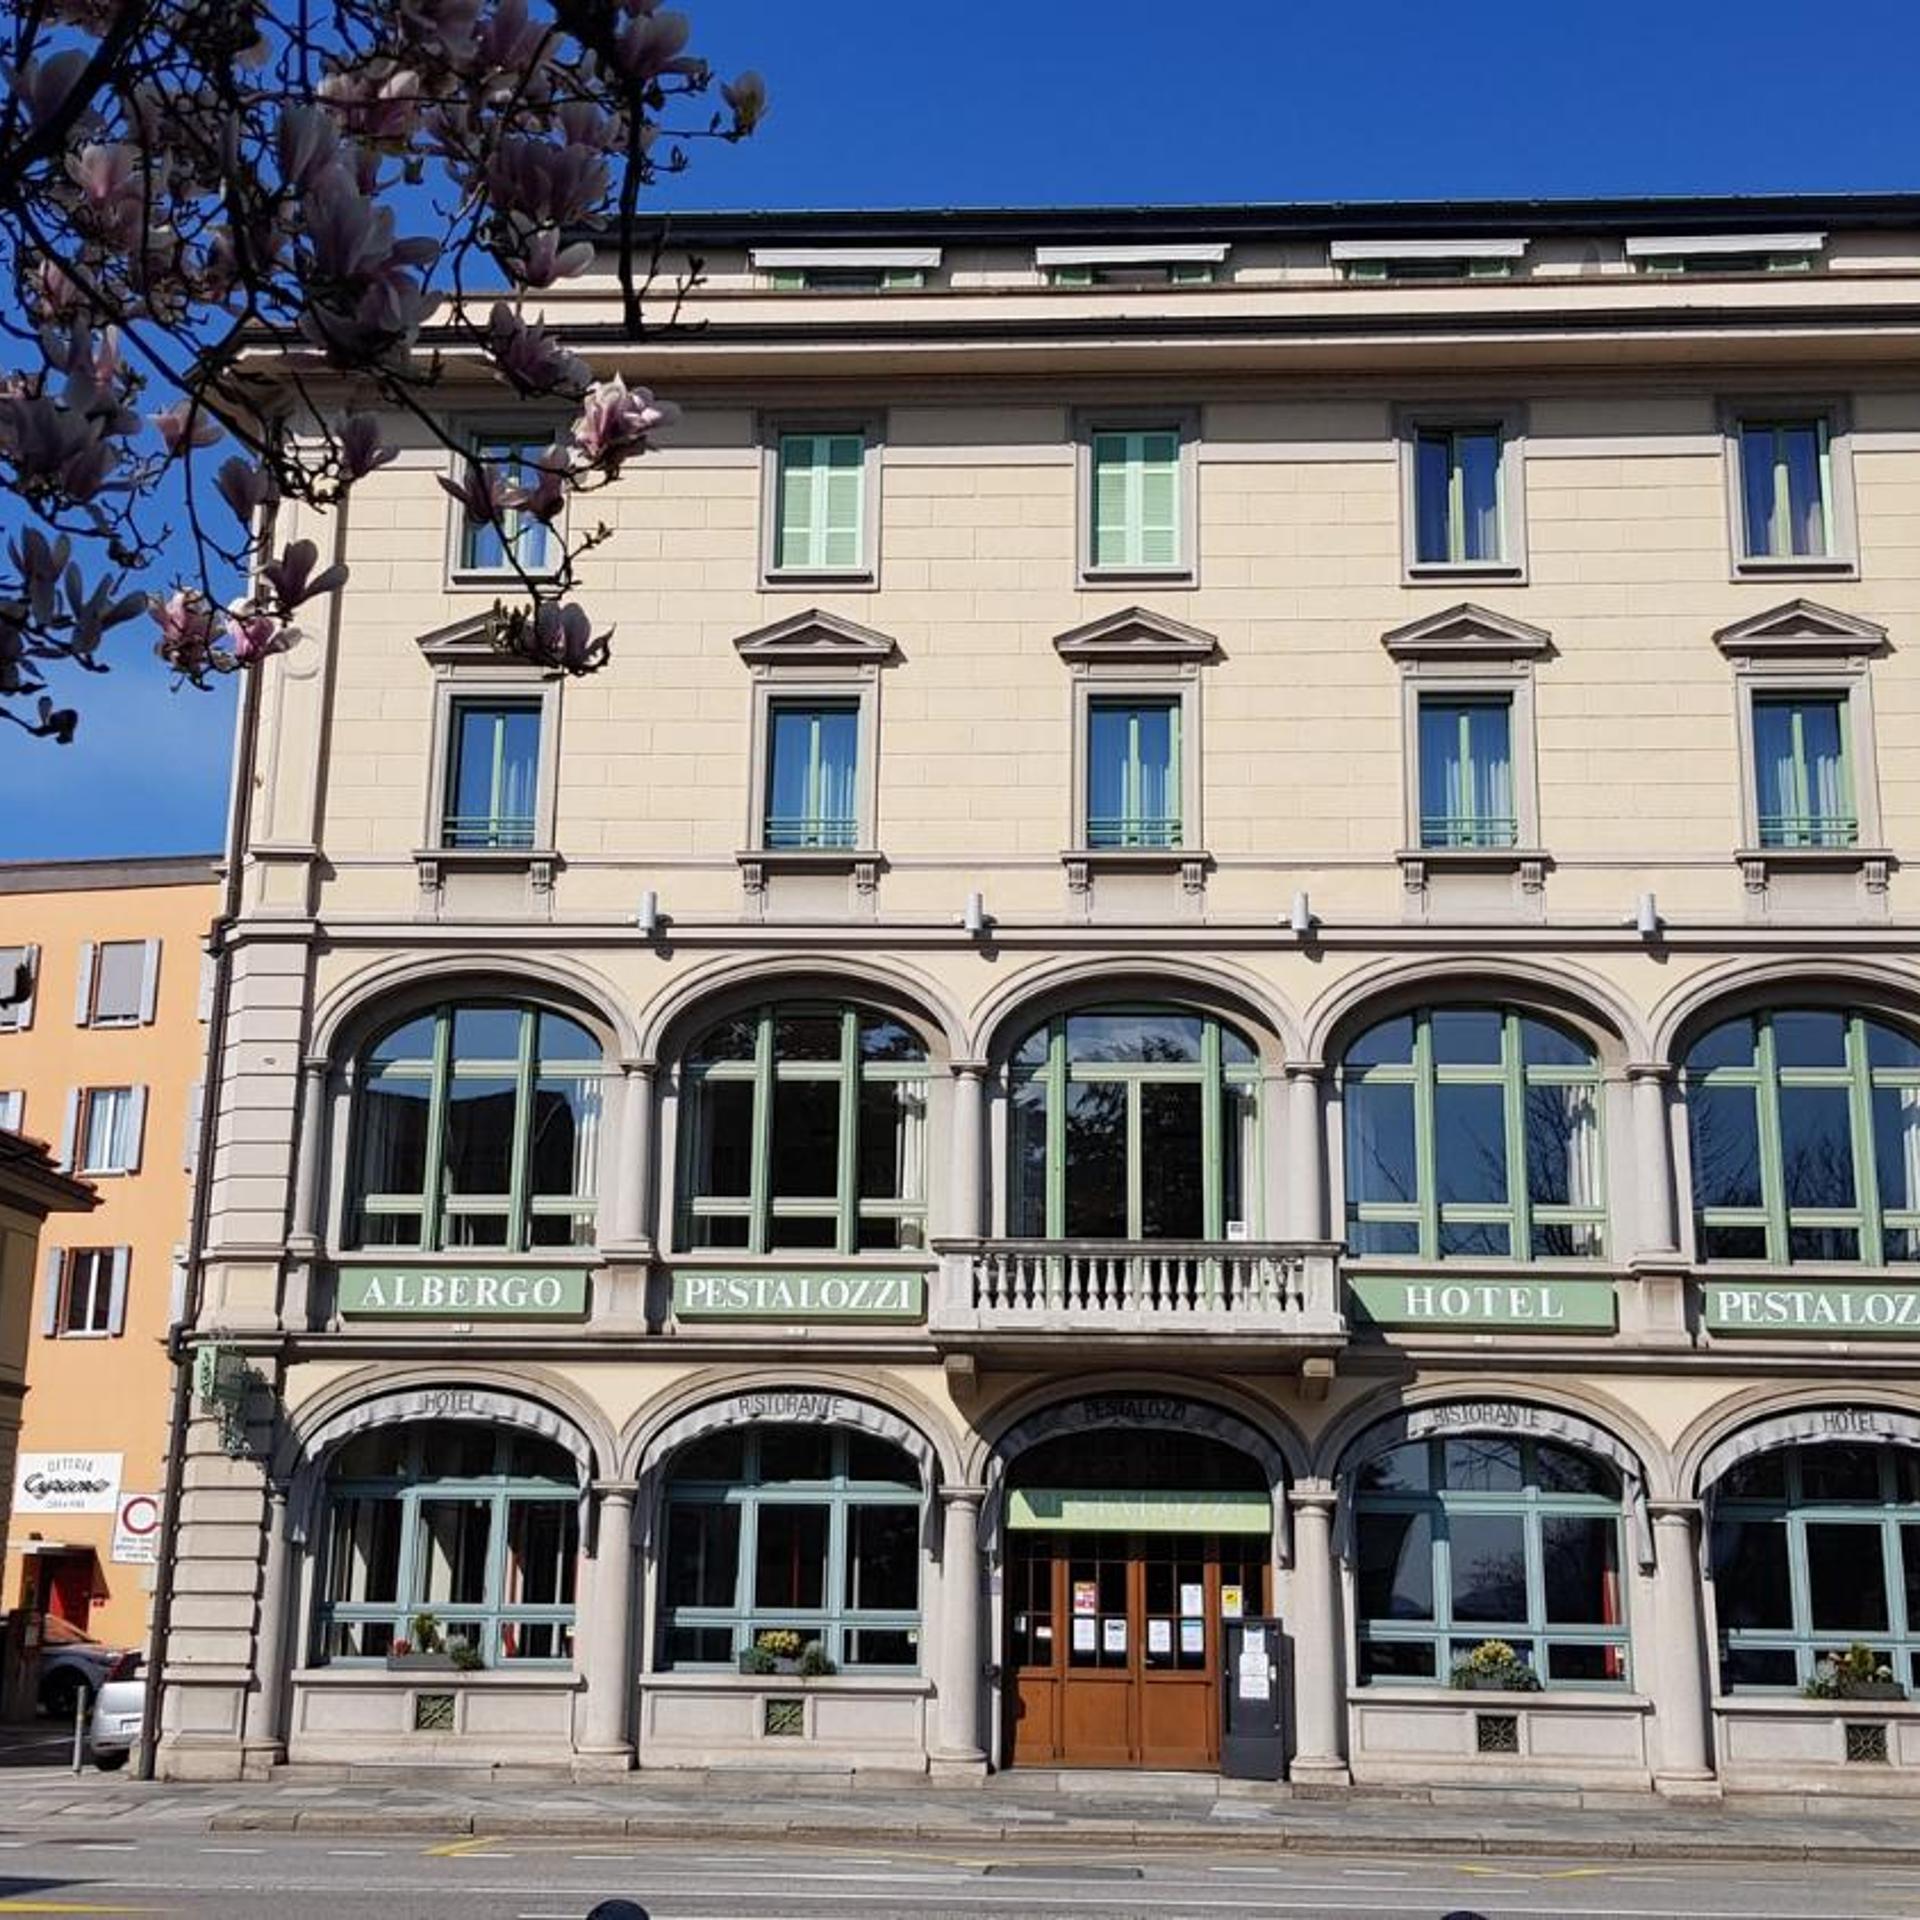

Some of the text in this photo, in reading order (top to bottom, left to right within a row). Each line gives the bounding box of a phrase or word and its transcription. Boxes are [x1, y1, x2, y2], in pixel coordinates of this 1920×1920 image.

[362, 1276, 562, 1307] ALBERGO
[685, 1277, 911, 1310] PESTALOZZI
[1405, 1286, 1564, 1318] HOTEL
[424, 1393, 475, 1412] HOTEL
[739, 1393, 841, 1416] RISTORANTE
[1432, 1403, 1540, 1426] RISTORANTE
[1822, 1412, 1879, 1432] HOTEL
